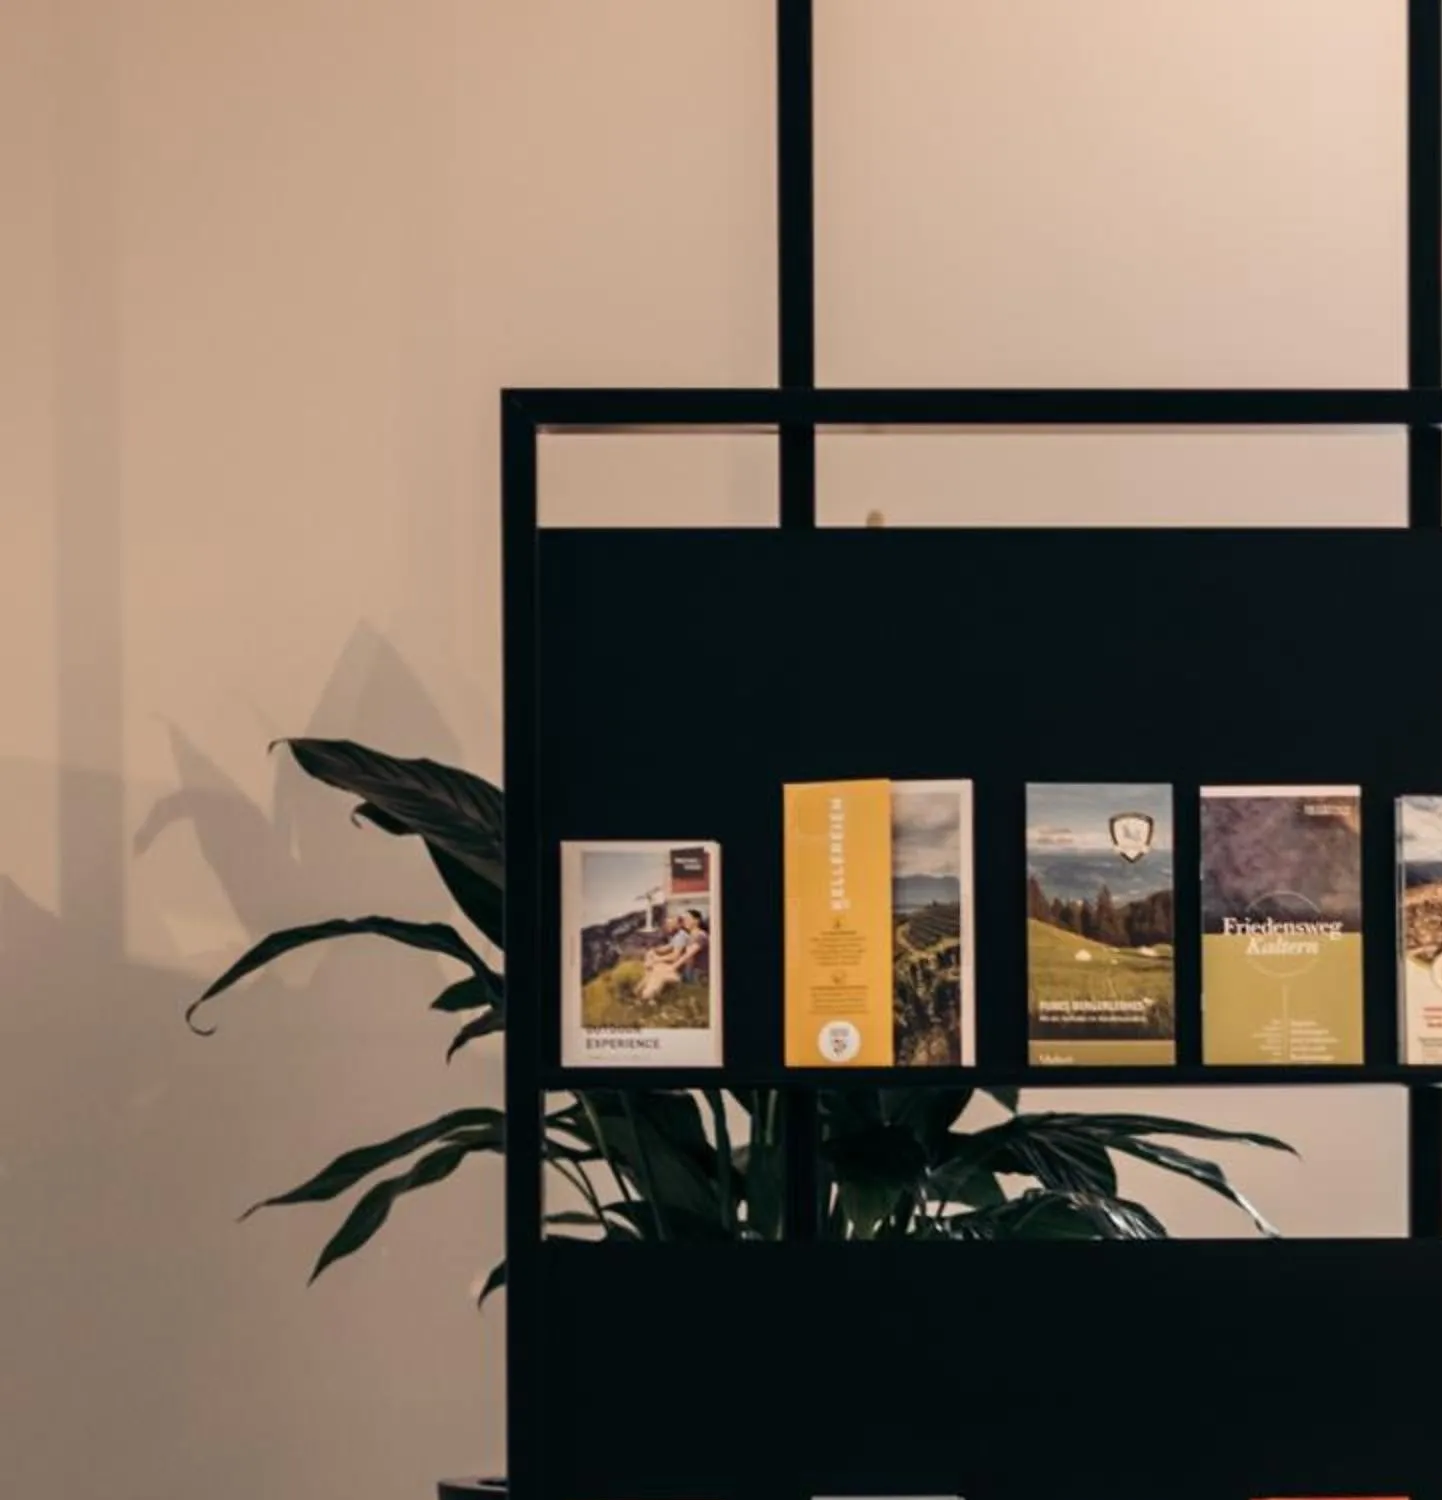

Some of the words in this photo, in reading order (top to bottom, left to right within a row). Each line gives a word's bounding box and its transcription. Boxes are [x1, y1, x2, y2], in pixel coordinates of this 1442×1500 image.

[1222, 917, 1344, 941] Friedensweg
[1246, 937, 1320, 955] Kaltern
[586, 1038, 660, 1050] EXPERIENCE
